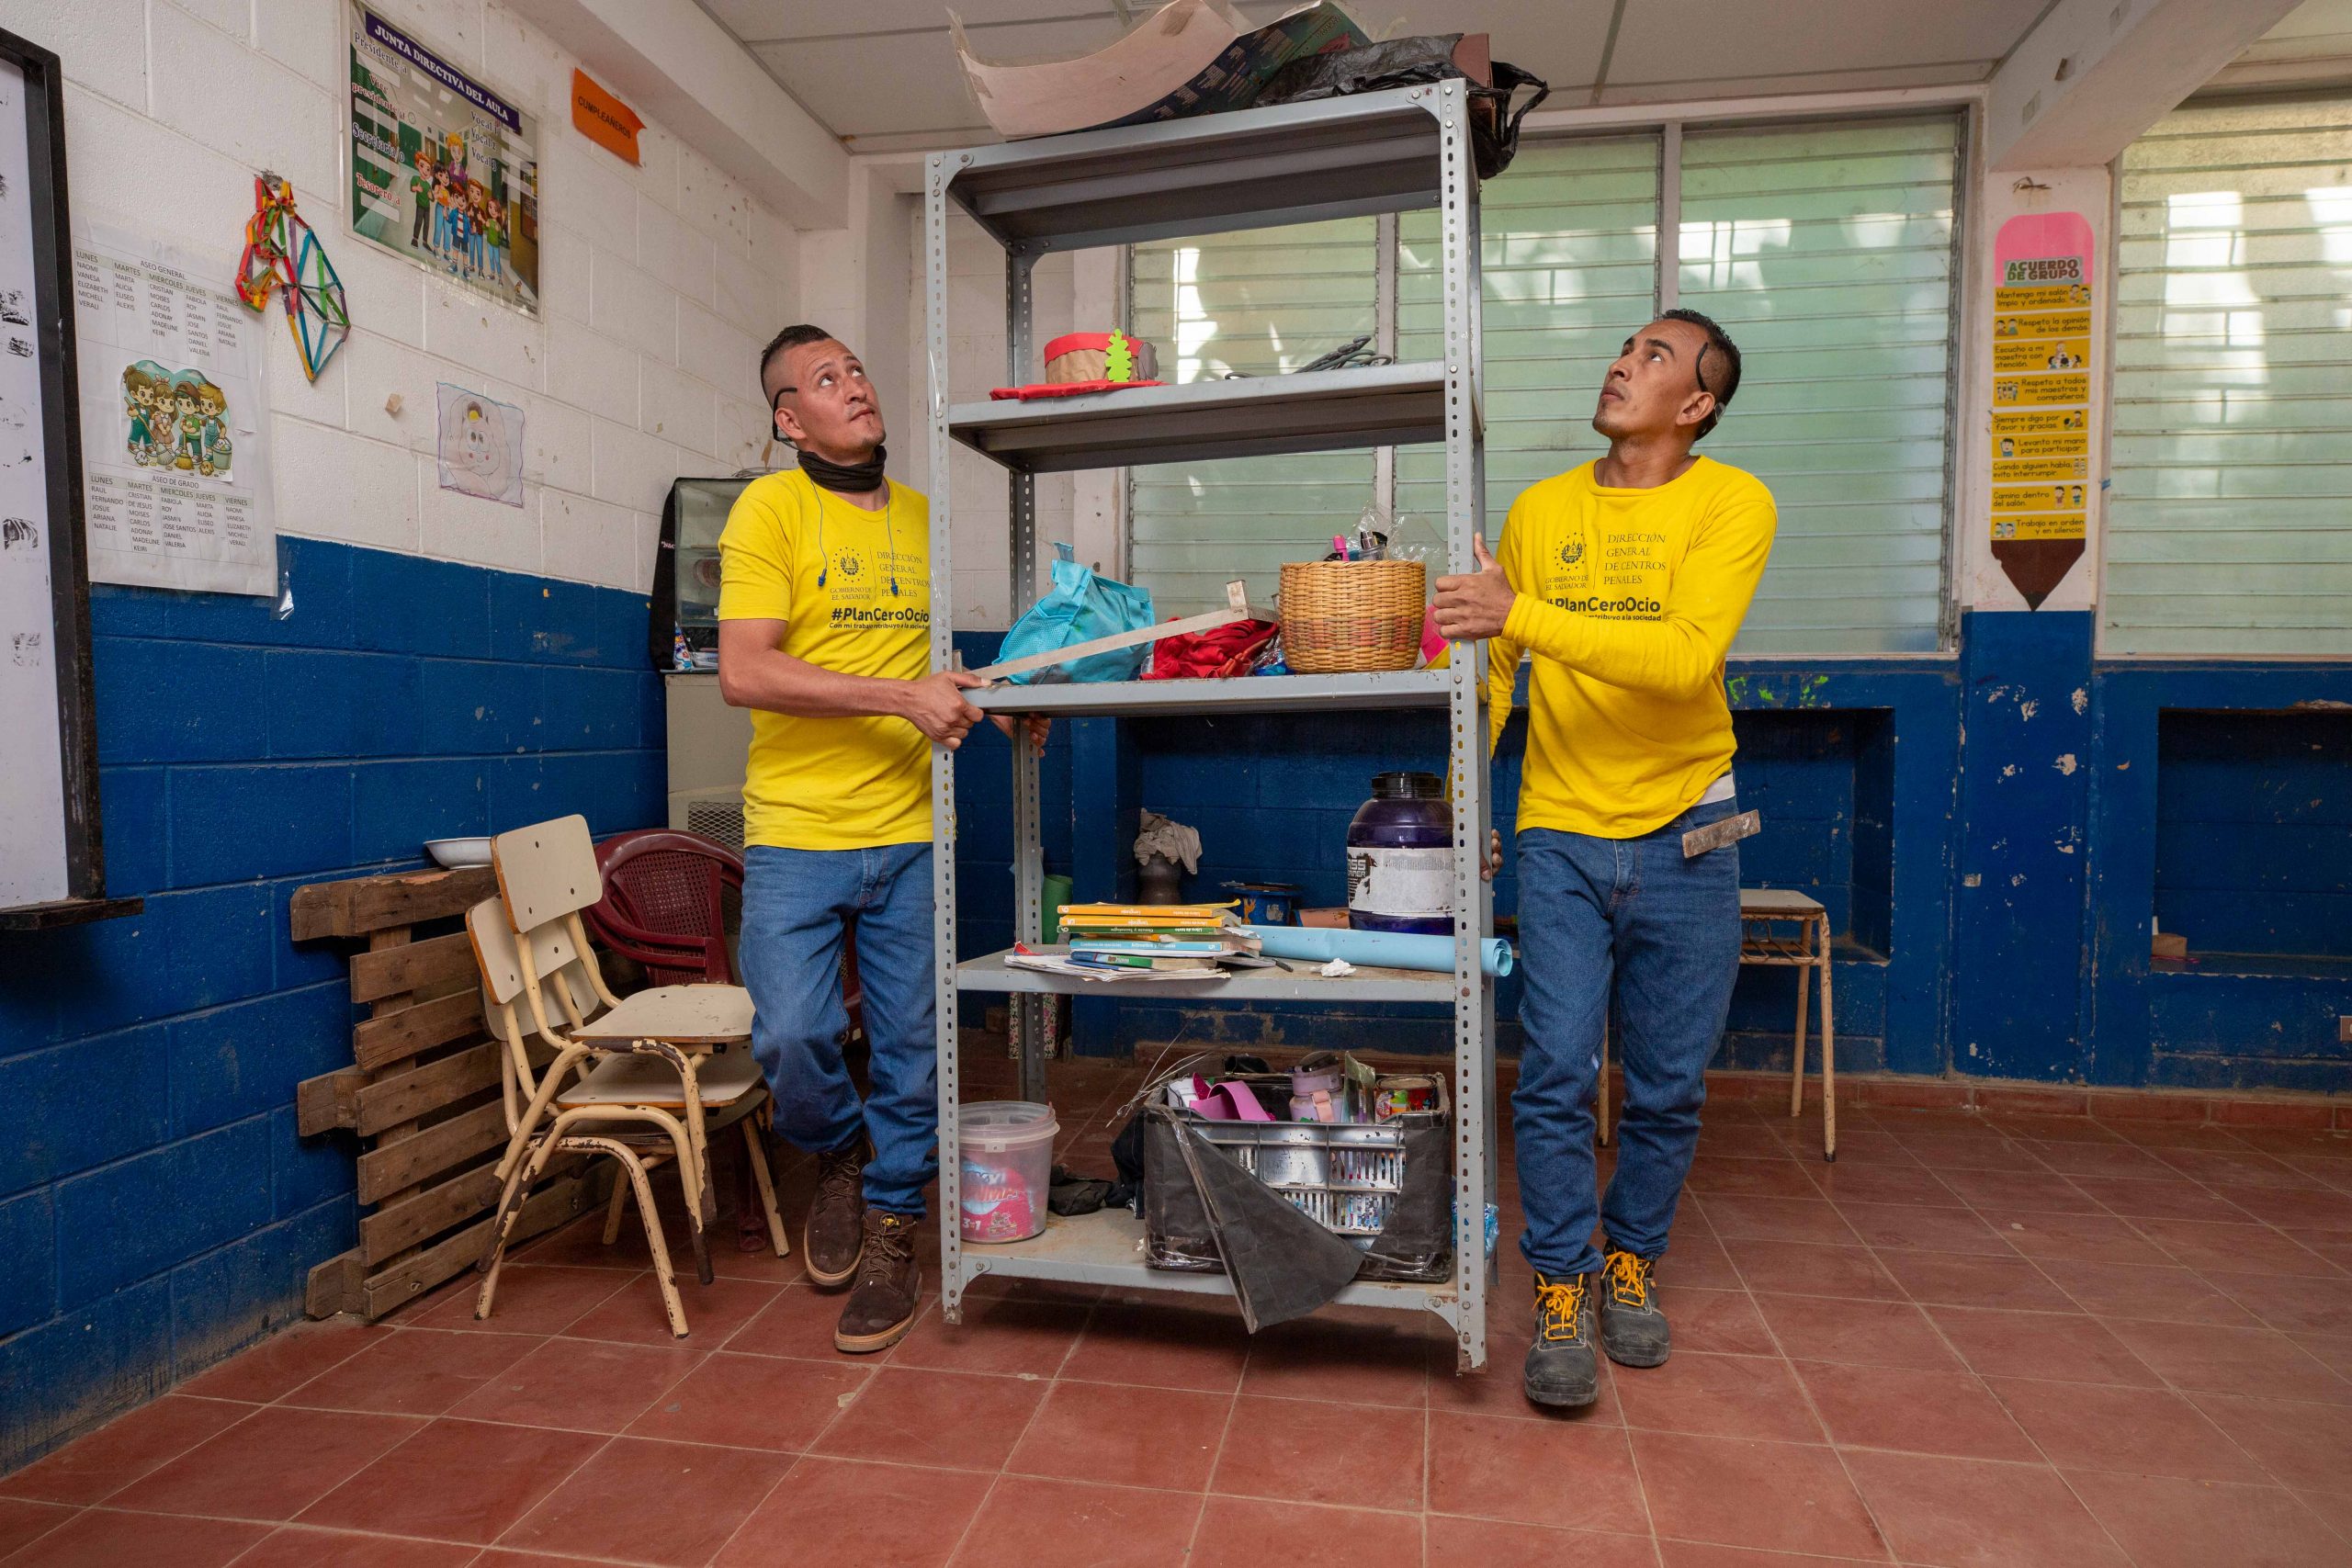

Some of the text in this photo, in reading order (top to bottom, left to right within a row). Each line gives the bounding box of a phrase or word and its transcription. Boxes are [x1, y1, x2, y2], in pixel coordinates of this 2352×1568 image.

[375, 25, 509, 121] JUNTA DIRECTIVA DEL AULA
[471, 110, 492, 131] Vocal
[577, 96, 631, 139] CUMPLEAÑEROS
[470, 127, 492, 148] Vocal
[471, 146, 492, 167] Vocal
[76, 250, 98, 264] LUNES
[76, 261, 98, 273] NAOMI
[114, 262, 141, 276] MARTES
[140, 260, 187, 280] ASEO GENERAL
[2008, 258, 2078, 272] ACUERDO
[77, 271, 100, 283] VANESA
[115, 273, 135, 285] MARTA
[2007, 268, 2080, 281] DE GRUPO
[149, 274, 184, 289] MIERCOLES
[77, 280, 108, 295] ELIZABETH
[115, 282, 133, 293] ALICIA
[149, 283, 174, 297] CRISTIAN
[186, 285, 207, 298] JUEVES
[78, 289, 104, 303] MICHELL
[116, 291, 135, 303] ELISEO
[150, 292, 171, 305] MOISES
[1996, 290, 2034, 300] Mantengo
[2048, 288, 2068, 296] salón
[116, 300, 136, 312] ALEXIS
[186, 294, 208, 307] FABIOLA
[215, 294, 240, 308] VIERNES
[1996, 299, 2018, 308] limpio
[150, 302, 172, 313] CARLOS
[186, 303, 197, 312] ROY
[151, 310, 174, 322] ADONAY
[187, 311, 207, 323] JASMIN
[216, 311, 243, 326] FERNANDO
[187, 321, 200, 330] JOSE
[2018, 318, 2050, 328] Respeto
[187, 329, 209, 341] SANTOS
[217, 329, 237, 341] ARIANA
[1995, 344, 2027, 354] Escucho
[1995, 353, 2028, 361] maestra
[2021, 377, 2086, 388] Respeto todos
[2041, 385, 2079, 394] maestros
[1994, 413, 2060, 424] Siempre digo por
[1996, 423, 2018, 431] favor
[2018, 438, 2051, 447] Levanto
[2020, 446, 2041, 455] para
[1993, 461, 2021, 470] Cuando
[2022, 461, 2049, 471] alguien
[91, 475, 114, 485] LUNES
[1993, 470, 2011, 479] evito
[127, 480, 153, 492] MARTES
[152, 475, 200, 490] ASEO DE GRADO
[91, 485, 107, 494] RAUL
[160, 487, 194, 499] MIERCOLES
[1994, 490, 2051, 500] Camino dentro
[91, 495, 124, 505] FERNANDO
[128, 491, 153, 501] CRISTIAN
[195, 492, 217, 502] JUEVES
[137, 502, 153, 511] JESUS
[196, 502, 214, 511] MARTA
[224, 497, 249, 507] VIERNES
[92, 504, 111, 513] JOSUE
[129, 509, 151, 518] MOISES
[161, 505, 173, 513] ROY
[93, 513, 117, 523] ARIANA
[130, 518, 152, 527] CARLOS
[198, 519, 215, 527] ELISEO
[2017, 518, 2046, 527] Trabajo
[2060, 517, 2085, 525] orden
[94, 522, 119, 532] NATALIE
[130, 527, 153, 536] ADONAY
[175, 525, 197, 533] SANTOS
[198, 527, 216, 536] ALEXIS
[164, 539, 187, 548] VALERIA
[1606, 547, 1652, 558] GENERAL
[878, 563, 917, 574] GENERAL
[1604, 560, 1667, 571] DE CENTROS
[880, 576, 891, 584] DE
[1544, 575, 1580, 584] GOBIERNO
[1603, 574, 1643, 585] PENALES
[881, 589, 919, 597] PEALES
[831, 607, 930, 623] #PlanCeroOcio
[1633, 614, 1662, 622] sociedad
